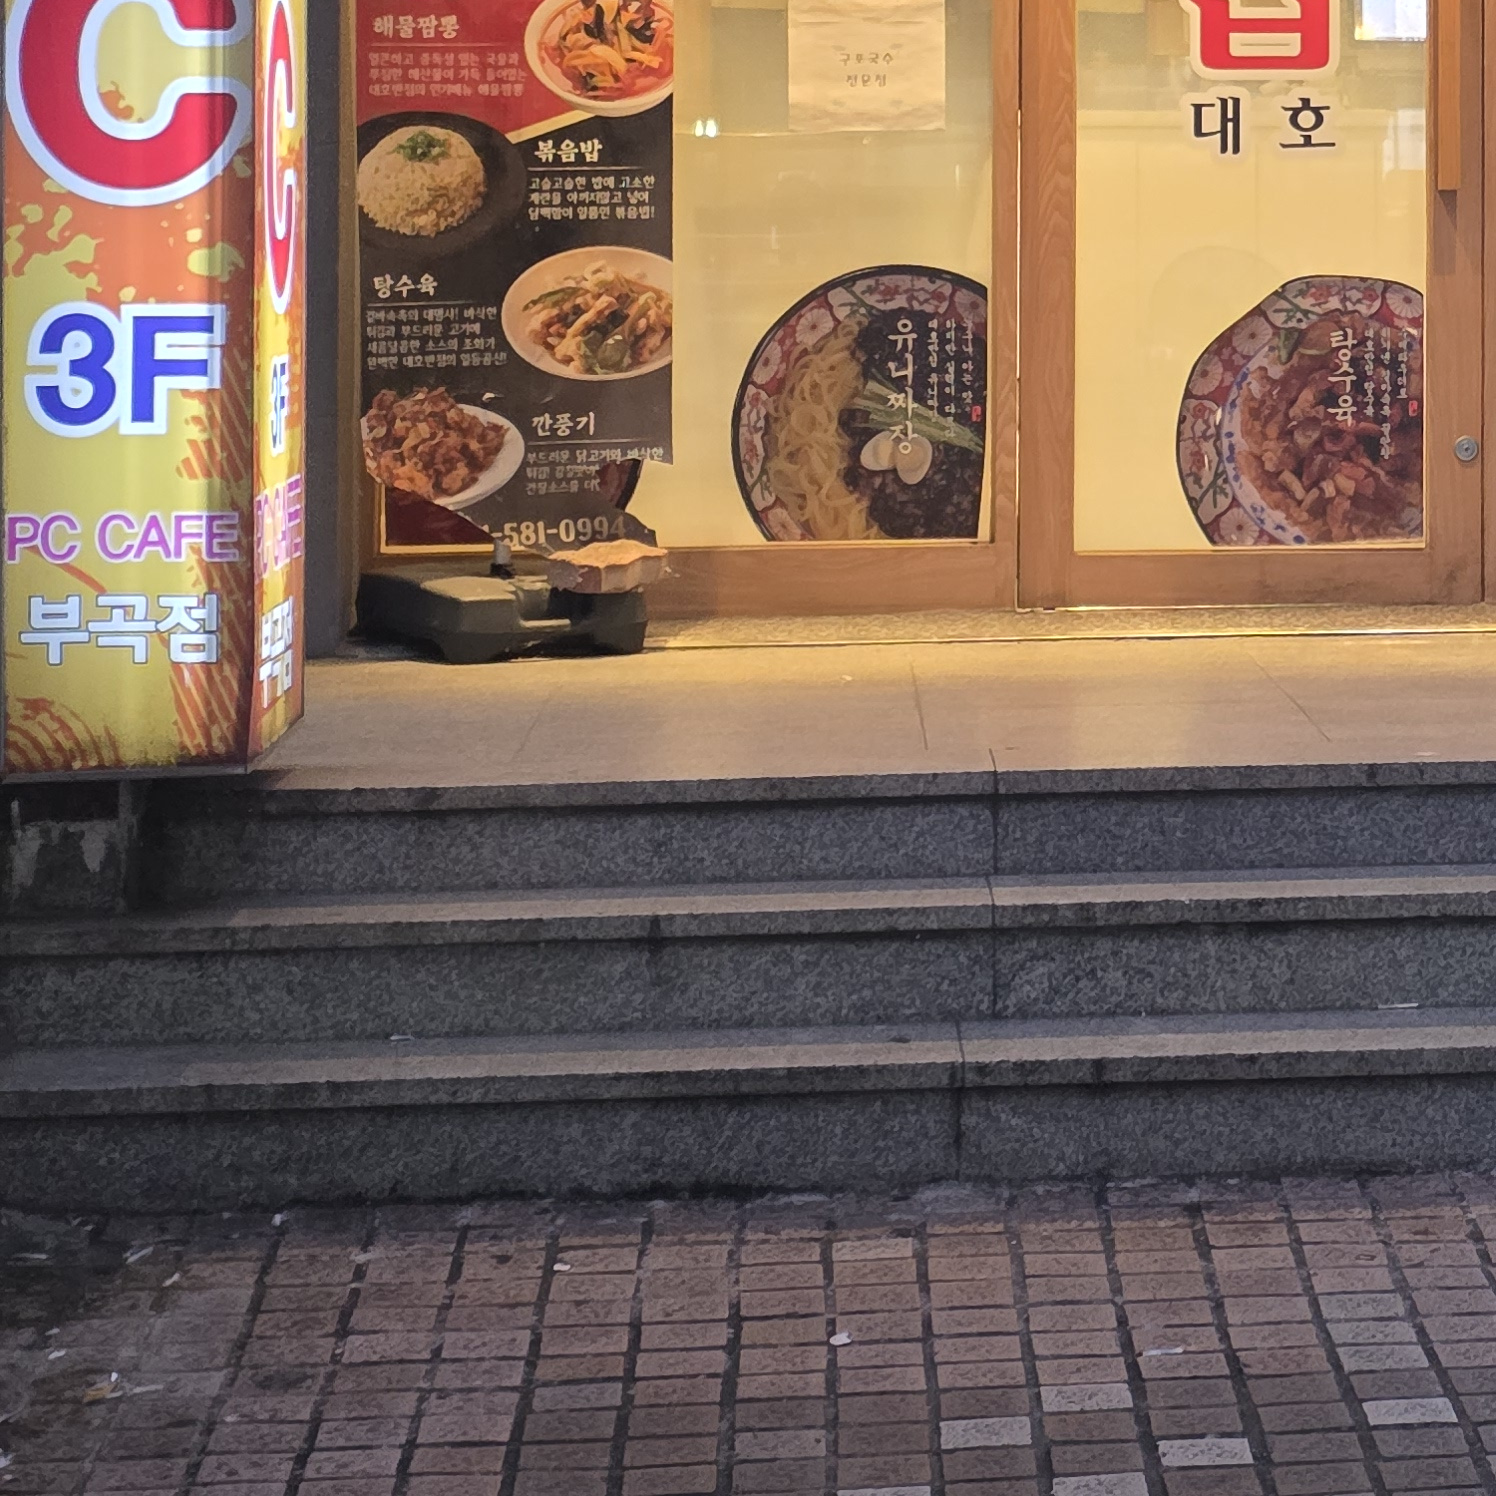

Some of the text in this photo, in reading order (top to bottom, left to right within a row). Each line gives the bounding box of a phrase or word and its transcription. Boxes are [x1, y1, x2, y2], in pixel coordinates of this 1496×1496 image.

[534, 138, 603, 163] 볶음밥
[373, 273, 438, 299] 탕수육
[24, 301, 227, 437] 3F
[887, 319, 918, 454] 유니짜장
[1326, 327, 1358, 427] 탕수육
[531, 411, 595, 436] 깐풍기
[6, 511, 240, 563] PC CAFE
[19, 592, 221, 666] 부곡점
